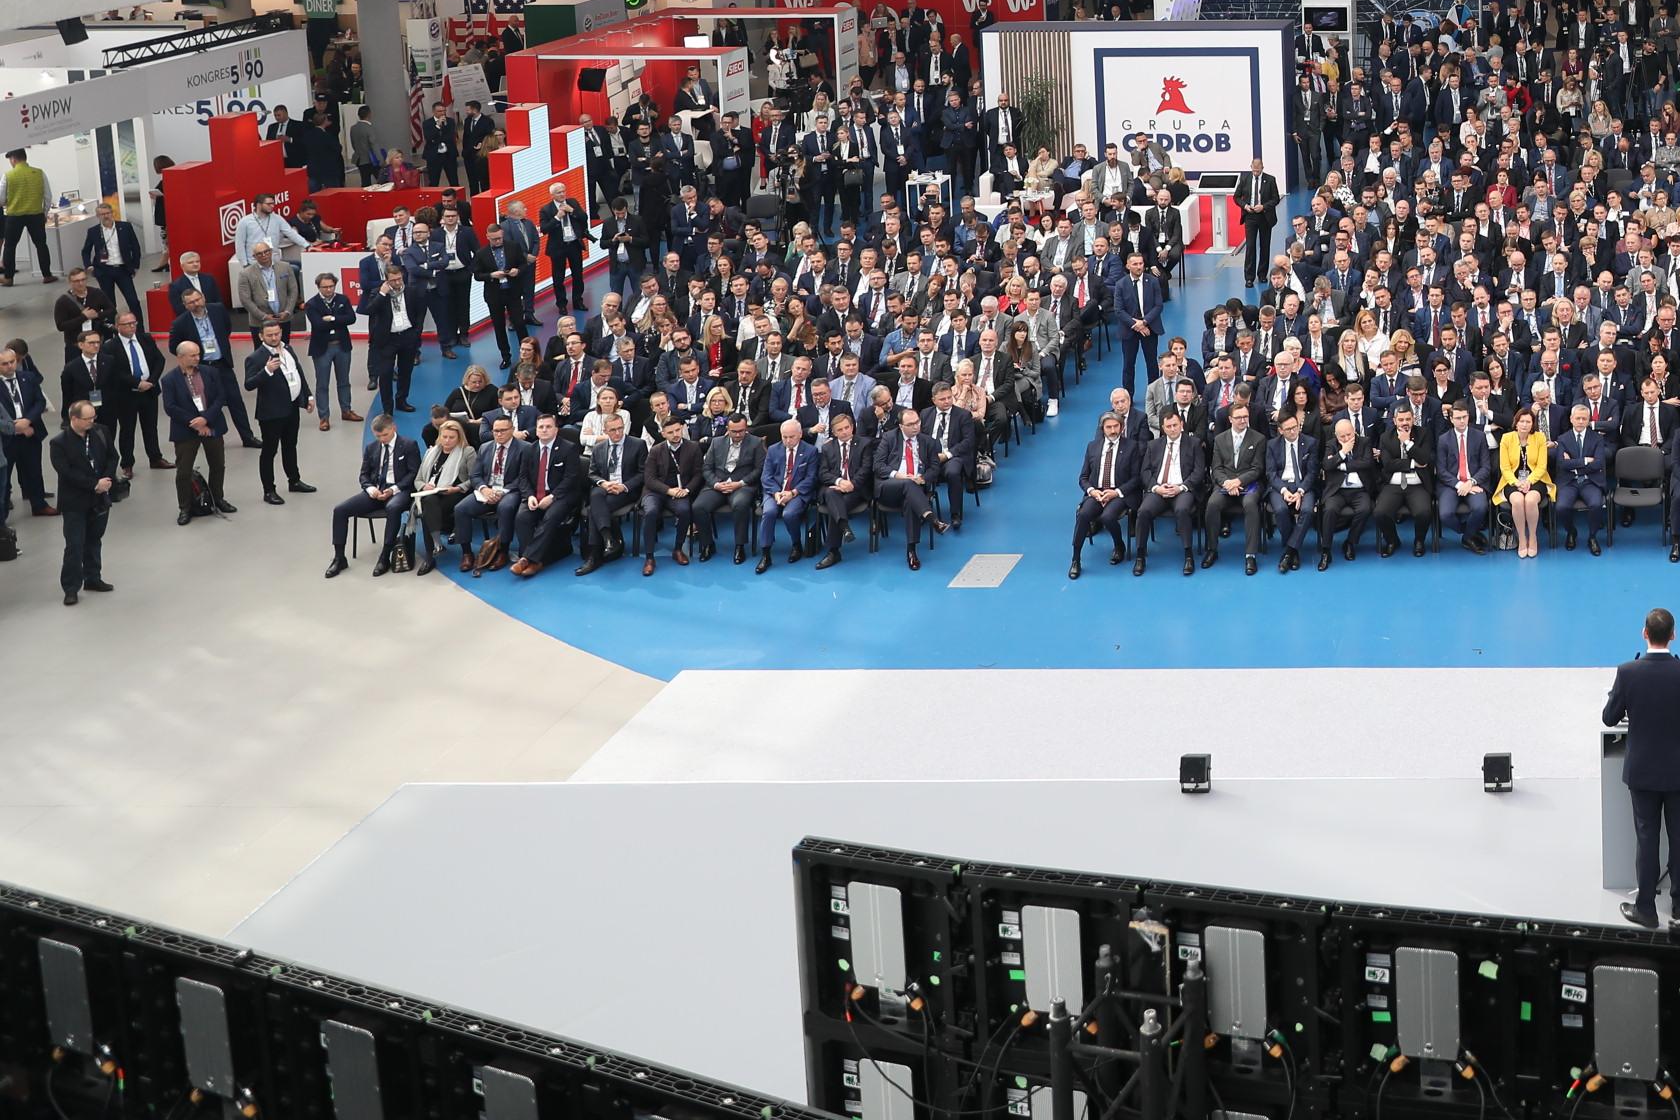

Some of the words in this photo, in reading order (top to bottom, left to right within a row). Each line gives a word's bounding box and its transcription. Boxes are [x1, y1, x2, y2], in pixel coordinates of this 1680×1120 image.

[728, 61, 745, 76] SIECI
[187, 67, 231, 89] KONGRES
[31, 97, 73, 123] PWPW
[1122, 119, 1231, 130] GRUPA
